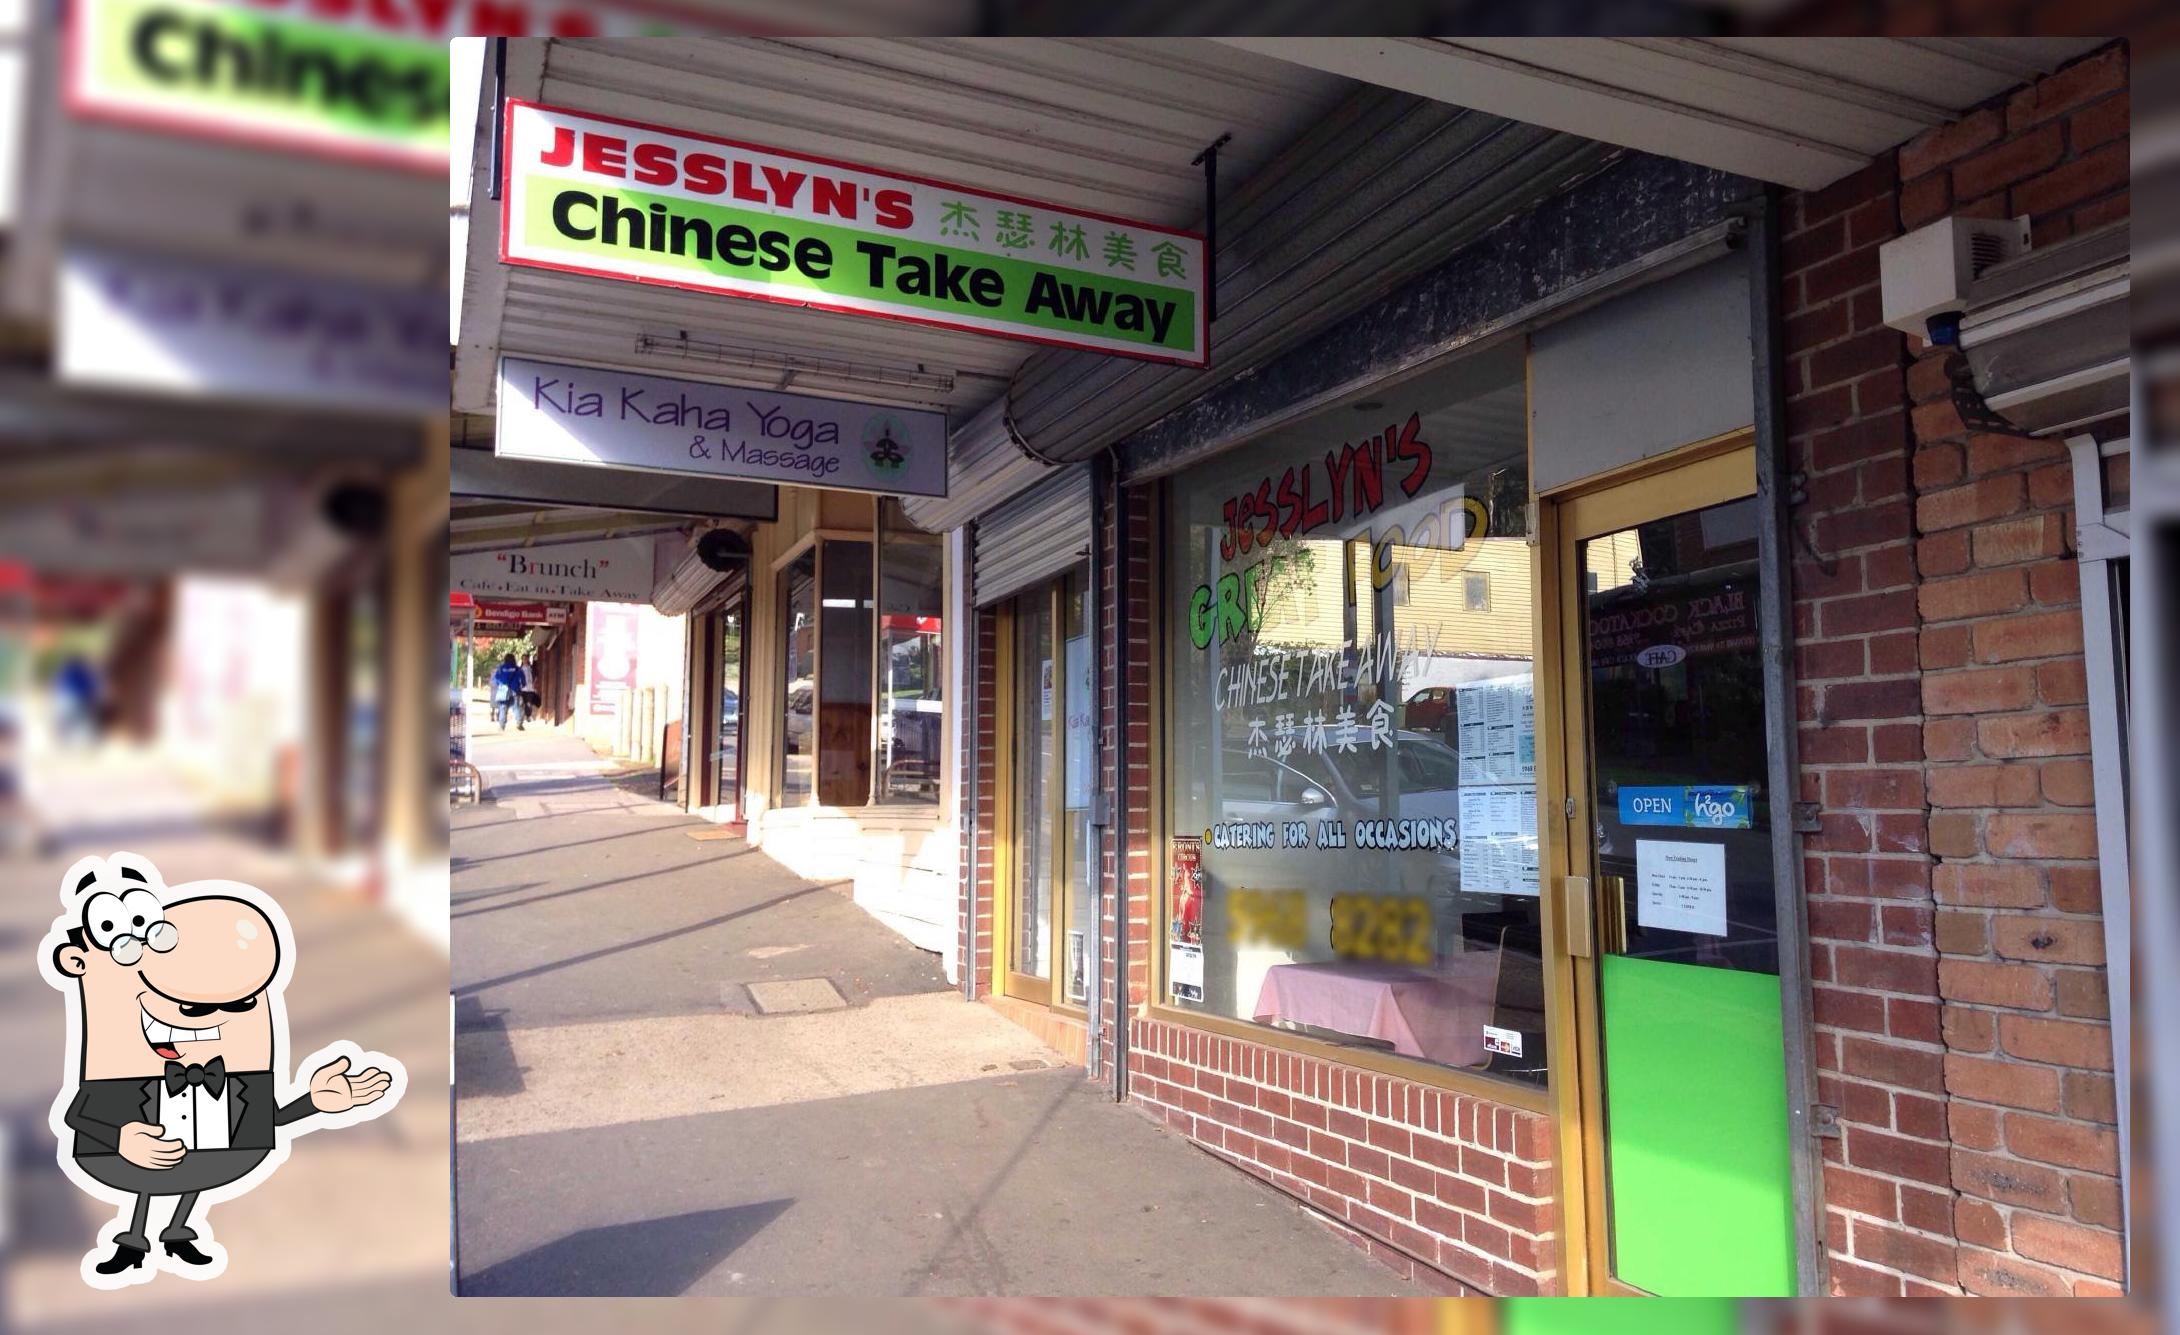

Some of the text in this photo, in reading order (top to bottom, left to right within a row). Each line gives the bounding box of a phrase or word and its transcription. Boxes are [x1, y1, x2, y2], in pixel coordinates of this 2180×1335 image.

[541, 126, 914, 230] JESSLYN'S
[552, 190, 1178, 344] Chinese Take Away
[939, 201, 1190, 281] 杰瑟林美食
[533, 376, 840, 450] Kia Kaha Yoga
[689, 435, 841, 478] & Massage
[485, 607, 543, 619] Bendigo Bank
[1215, 621, 1443, 712] CHINESE TAKE AWAY
[1247, 698, 1395, 760] 杰瑟林美食
[1213, 817, 1459, 850] CATERING FOR ALL OCCASIONS
[1632, 797, 1672, 814] OPEN
